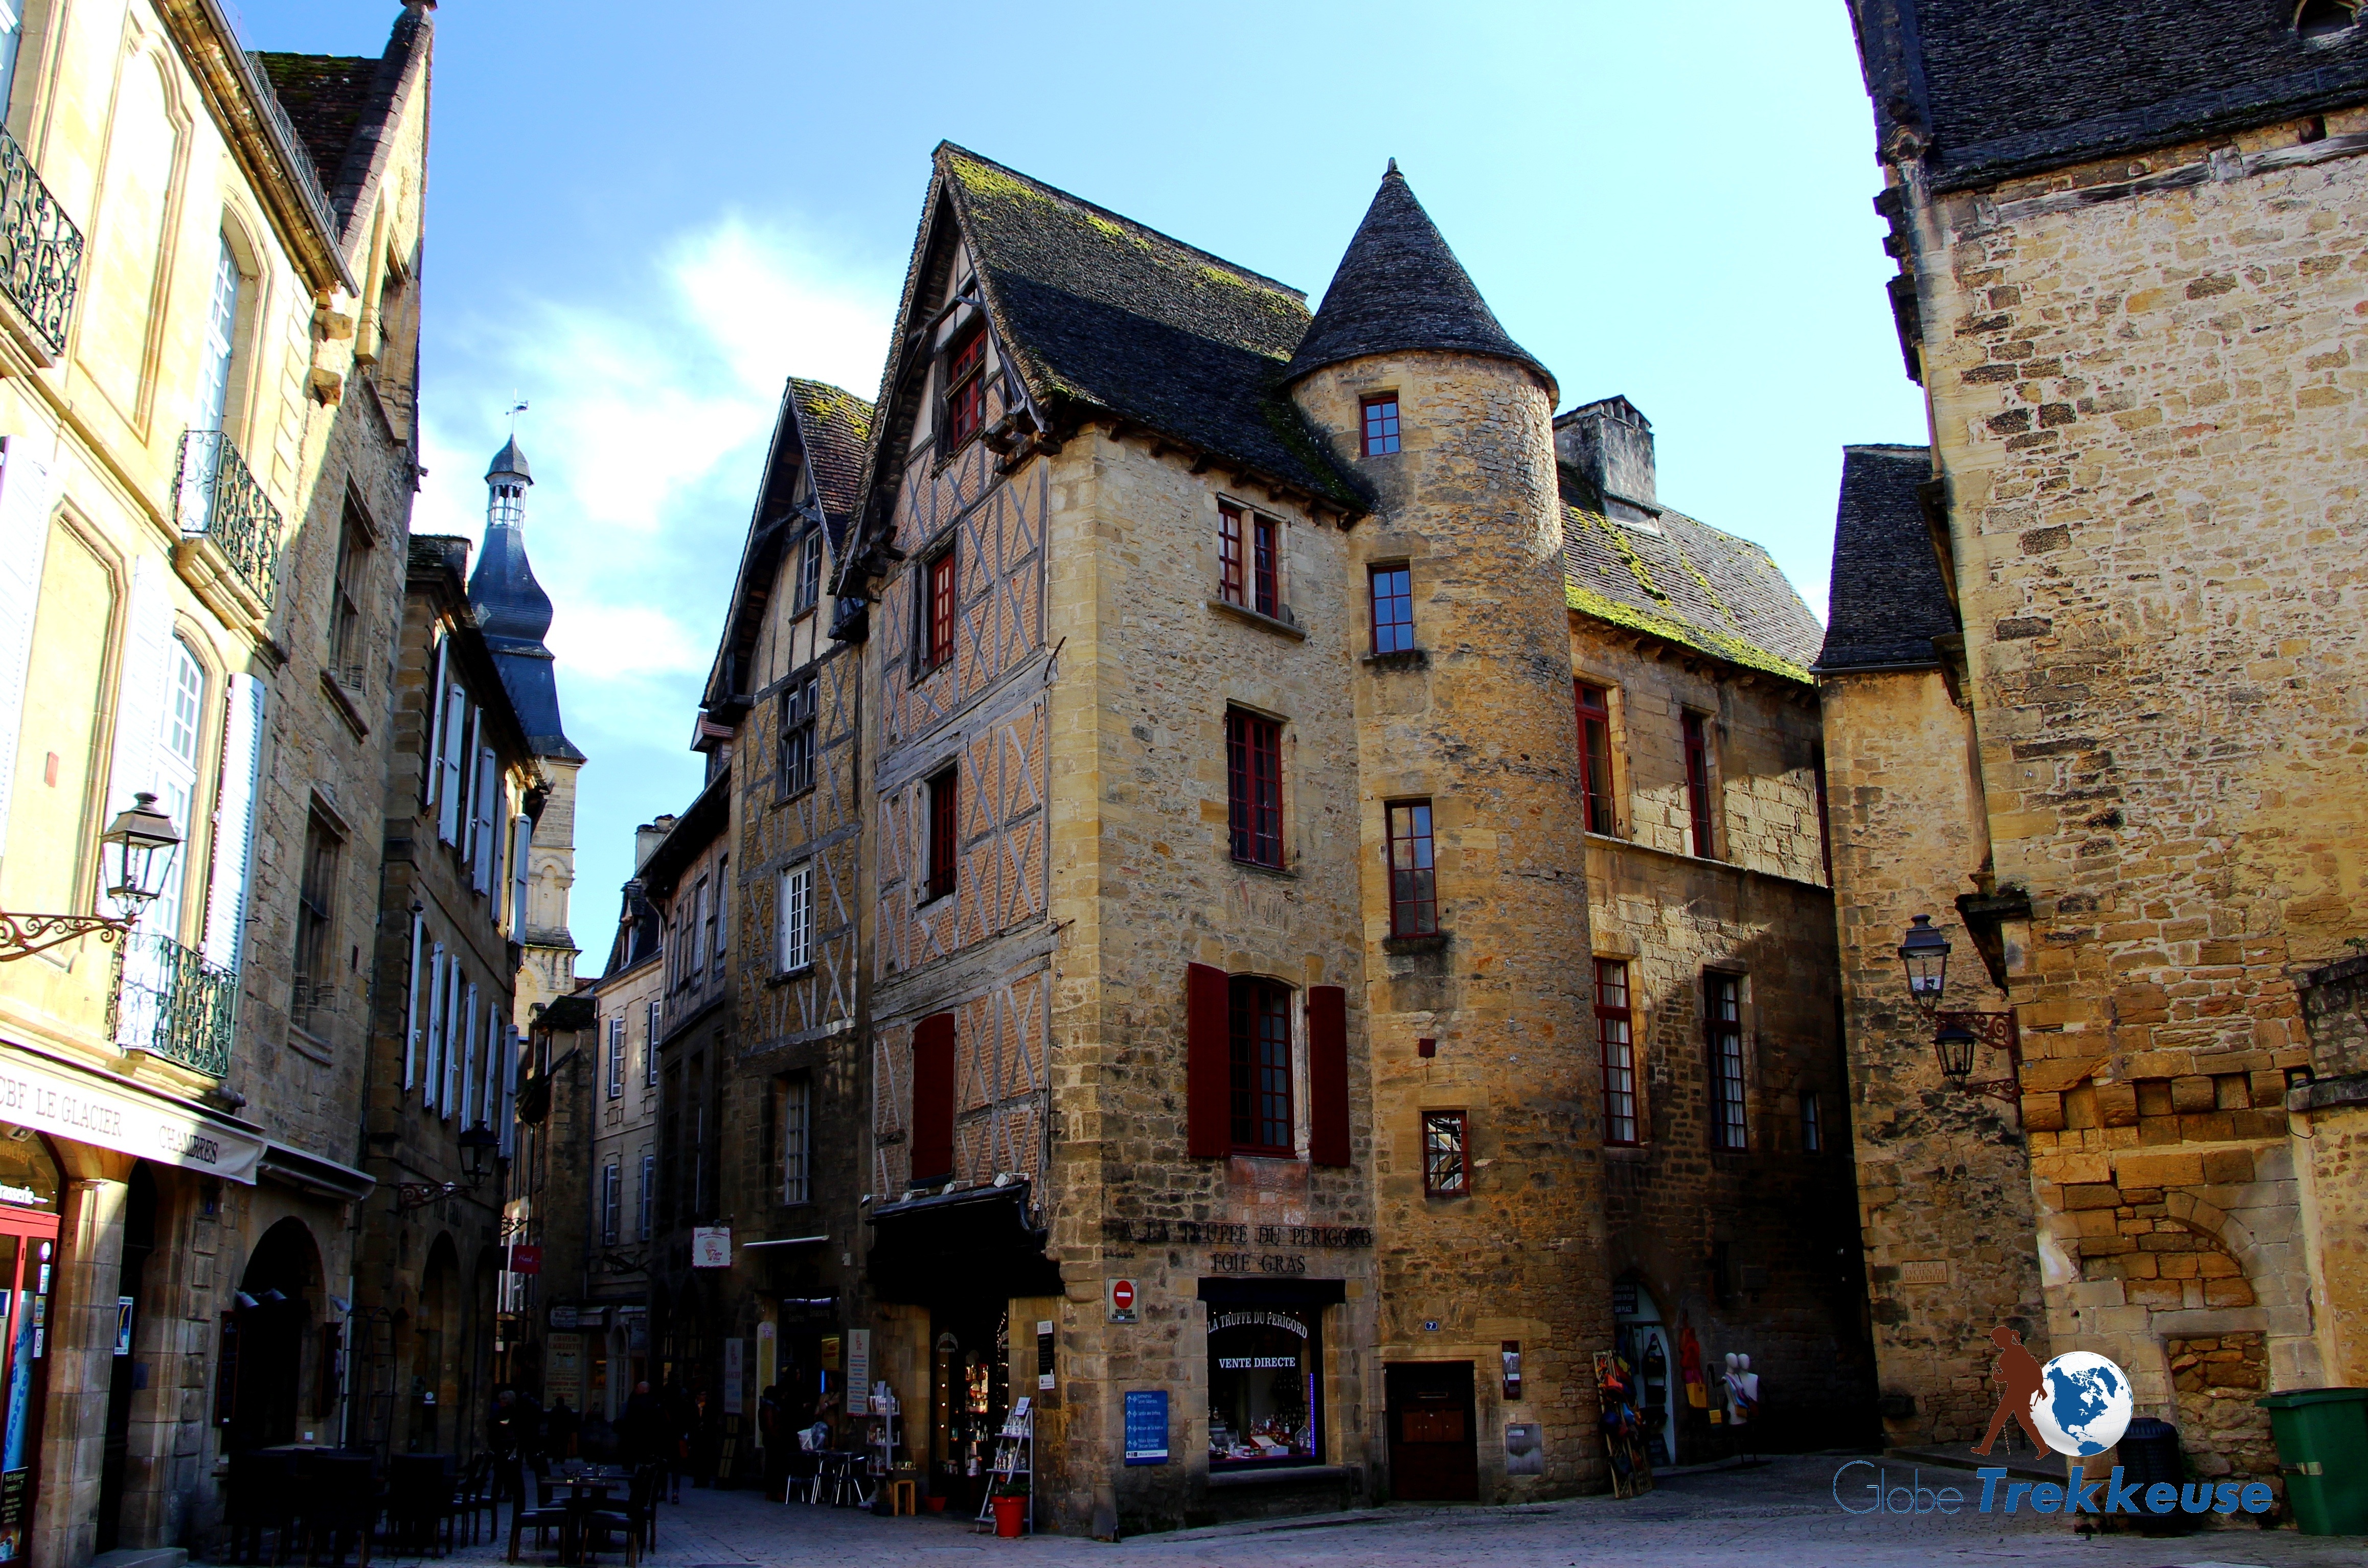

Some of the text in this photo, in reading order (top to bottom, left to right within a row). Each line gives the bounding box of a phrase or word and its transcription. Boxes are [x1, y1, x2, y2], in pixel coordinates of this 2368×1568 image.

[36, 1088, 56, 1118] LE
[61, 1096, 122, 1137] GLACIER
[158, 1125, 219, 1165] CHAMBRES
[1179, 1221, 1248, 1243] TRUFFE
[1258, 1227, 1280, 1244] DU
[1292, 1227, 1372, 1246] PERIGORD
[1212, 1253, 1306, 1273] FOIE GRAS
[1207, 1312, 1307, 1339] LA TRUFFE DU PERIGORD
[1219, 1357, 1295, 1368] VENTE DIRECTE
